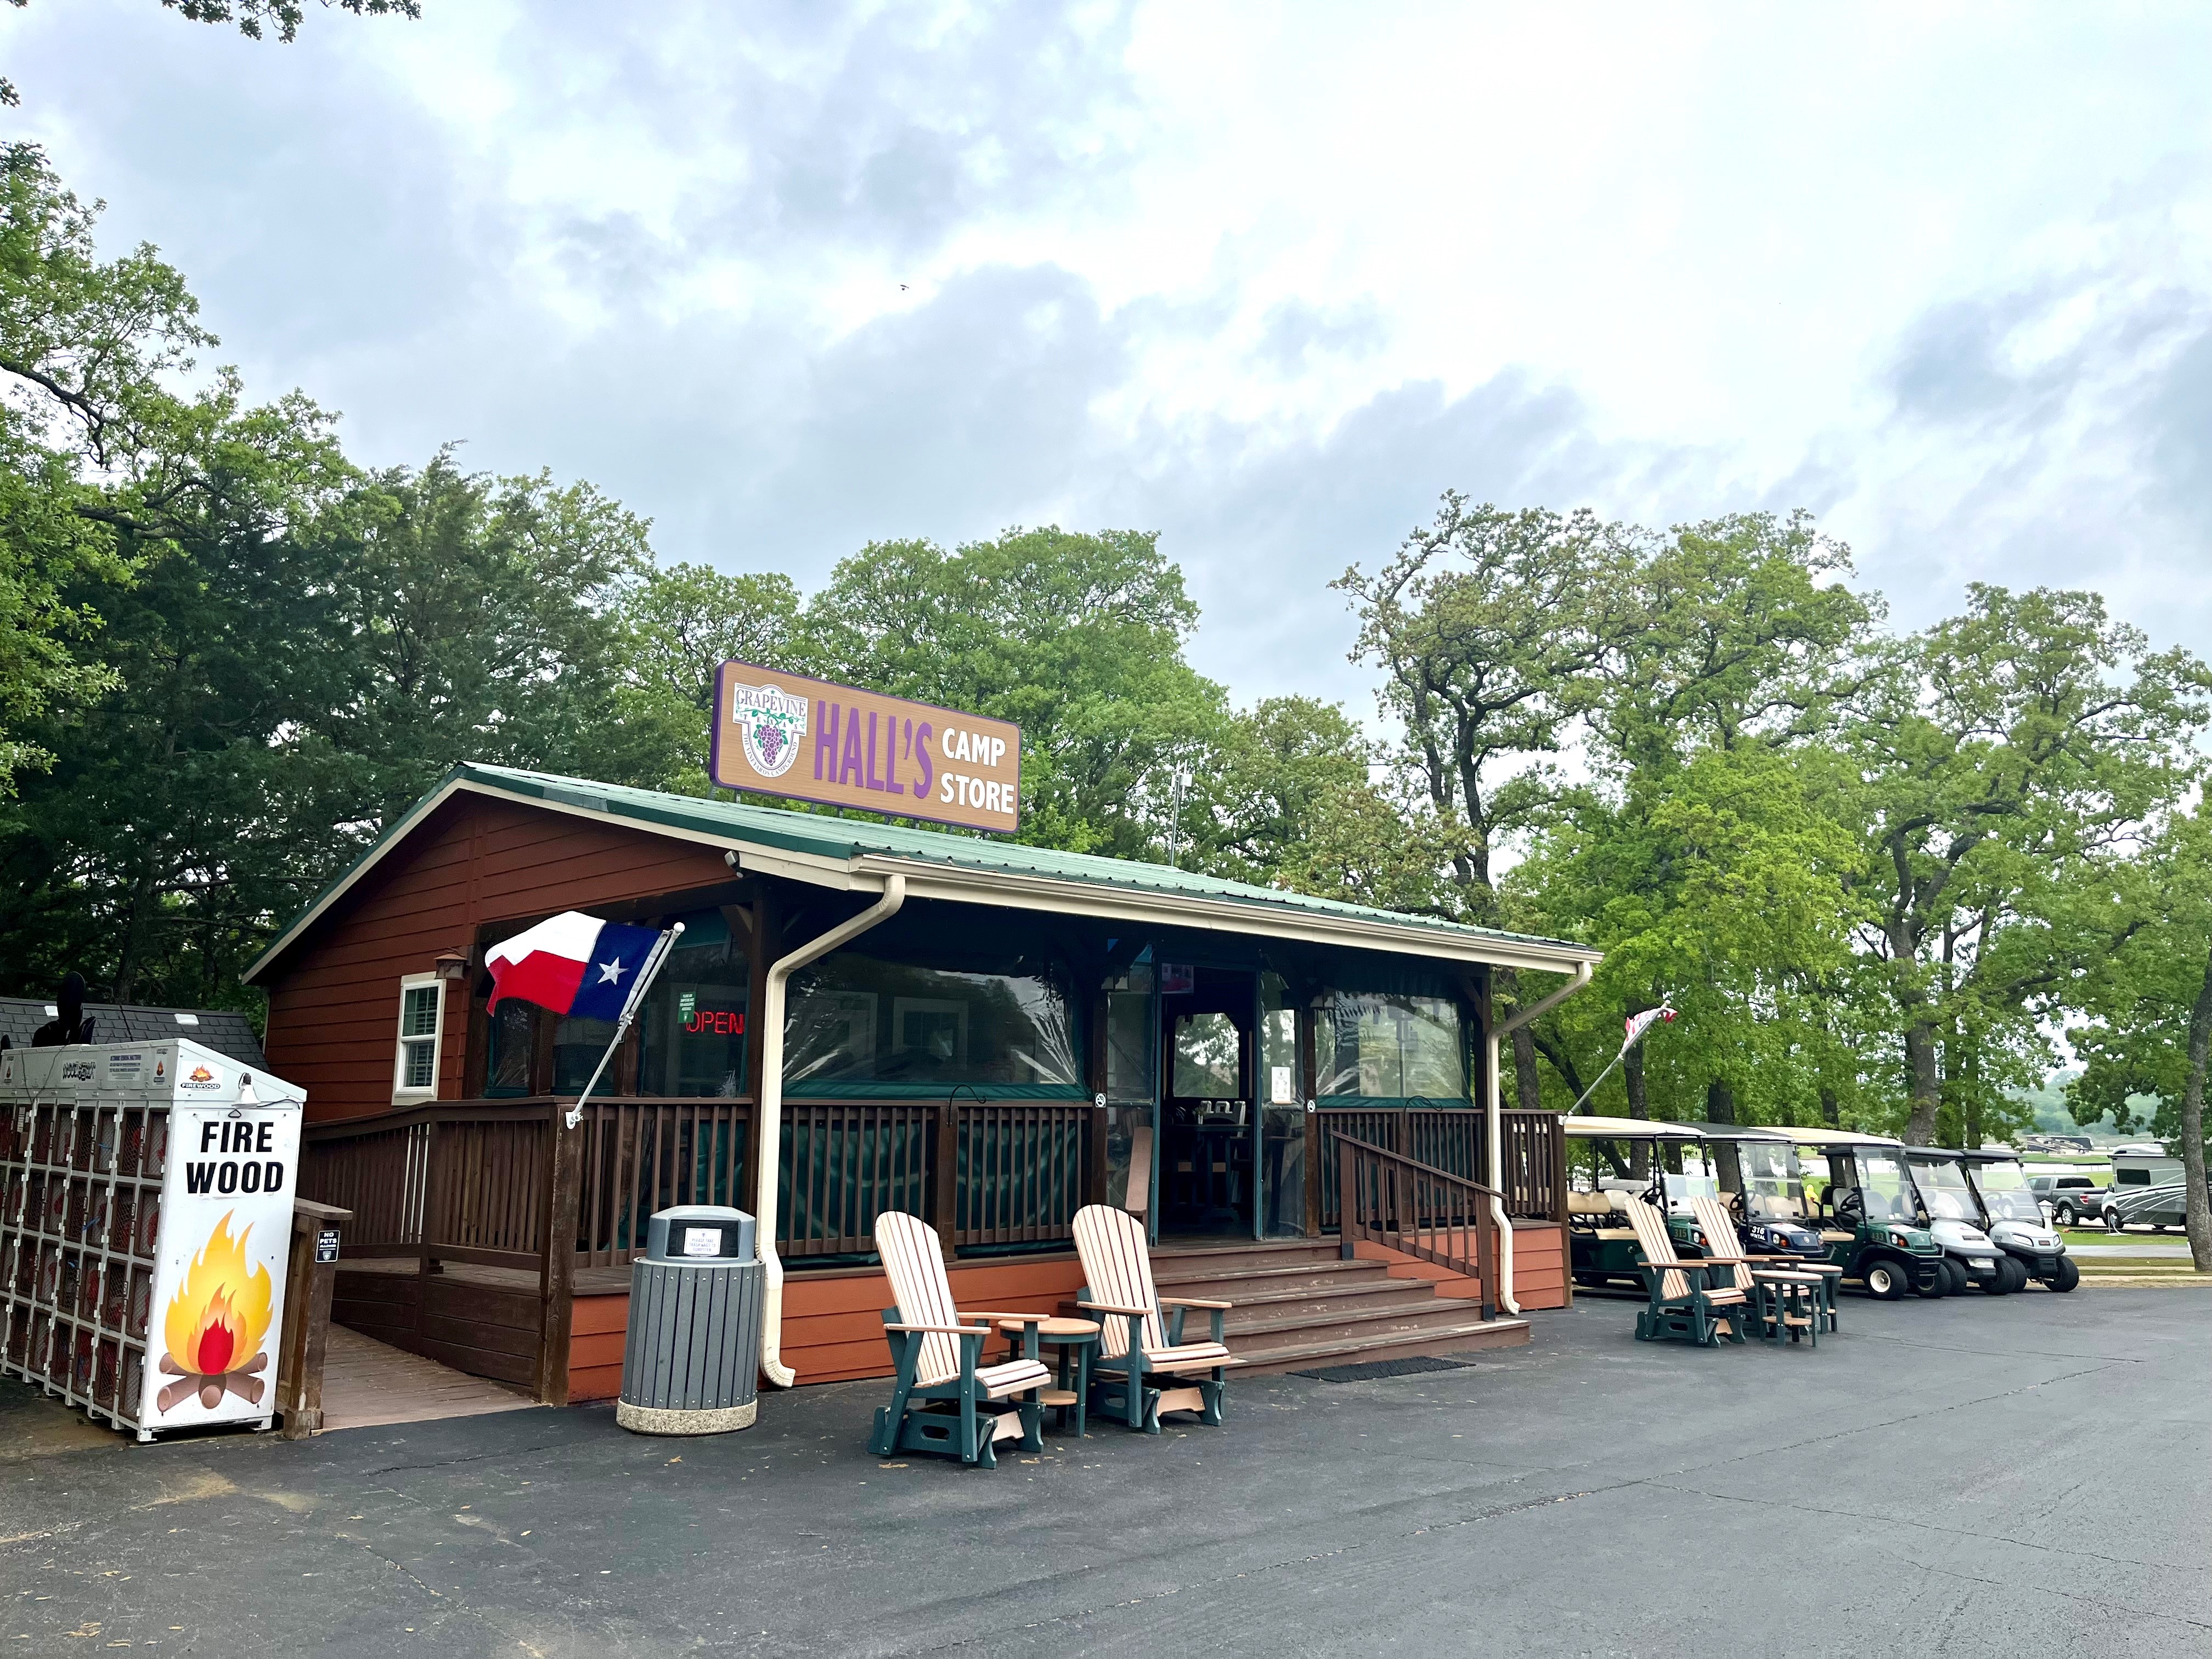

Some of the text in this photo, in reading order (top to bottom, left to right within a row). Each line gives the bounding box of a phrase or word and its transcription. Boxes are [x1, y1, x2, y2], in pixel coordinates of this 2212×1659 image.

[736, 689, 806, 716] GRAPEVINE
[743, 714, 798, 730] TEXAS
[746, 747, 770, 776] VINEYARDS
[771, 742, 798, 776] CAMPGROUND
[814, 700, 933, 799] HALL'S
[942, 727, 1006, 767] CAMP
[940, 772, 1014, 814] STORE
[686, 1011, 744, 1034] OPEN
[200, 1121, 274, 1153] FIRE
[186, 1161, 284, 1194] WOOD
[1674, 1228, 1687, 1238] 315
[1752, 1226, 1765, 1234] 316
